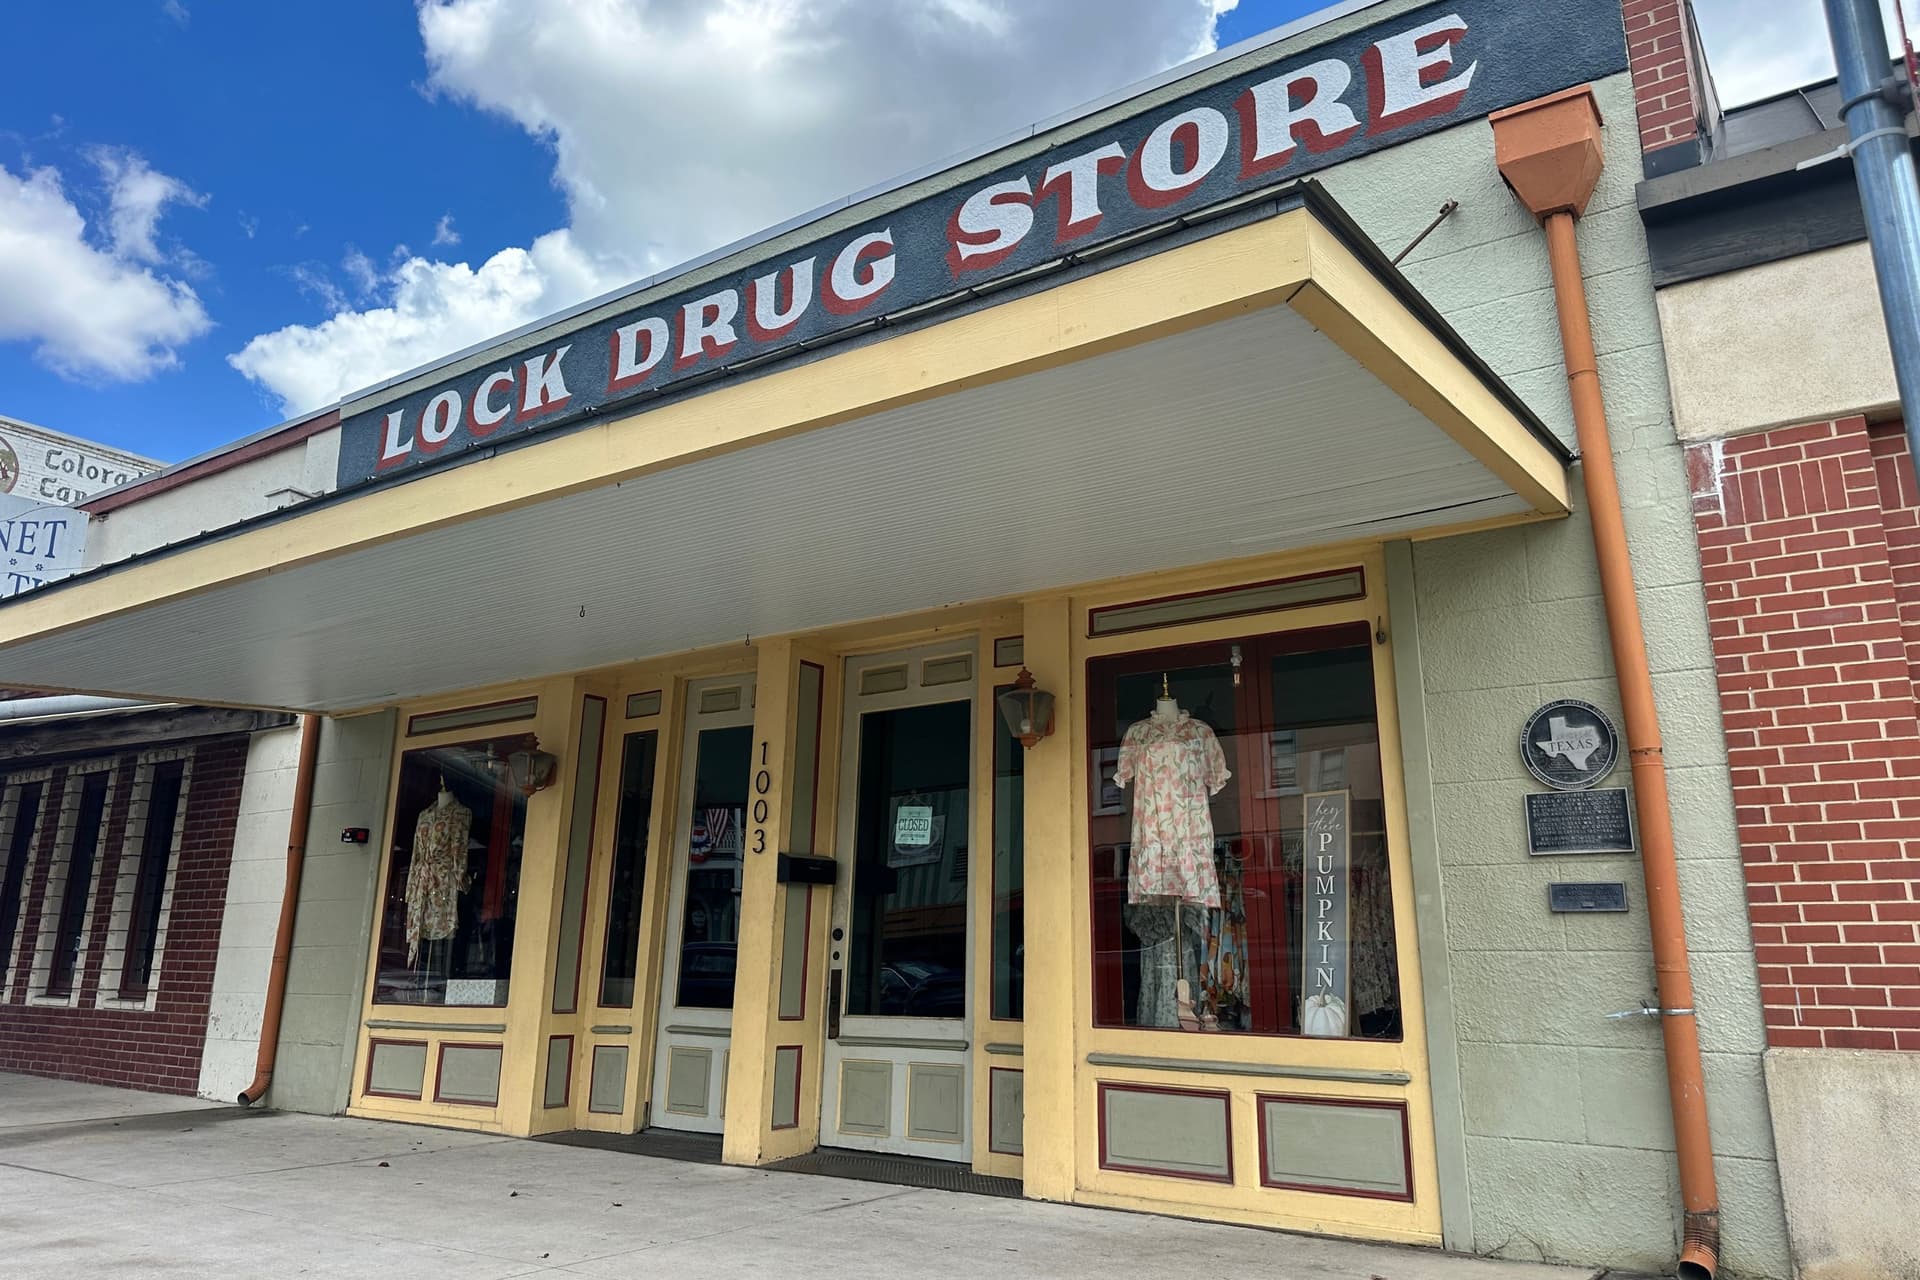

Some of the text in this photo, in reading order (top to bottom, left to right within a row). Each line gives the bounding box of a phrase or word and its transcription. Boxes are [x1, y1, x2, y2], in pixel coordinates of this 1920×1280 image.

[377, 13, 1478, 470] LOCK DRUG STORE
[45, 449, 143, 485] Colora
[1548, 738, 1594, 752] TEXAS
[752, 741, 770, 854] 1003
[1315, 799, 1343, 823] hey
[898, 818, 929, 832] CLOSED
[1309, 816, 1343, 836] there
[1315, 832, 1336, 988] PUMPKIN
